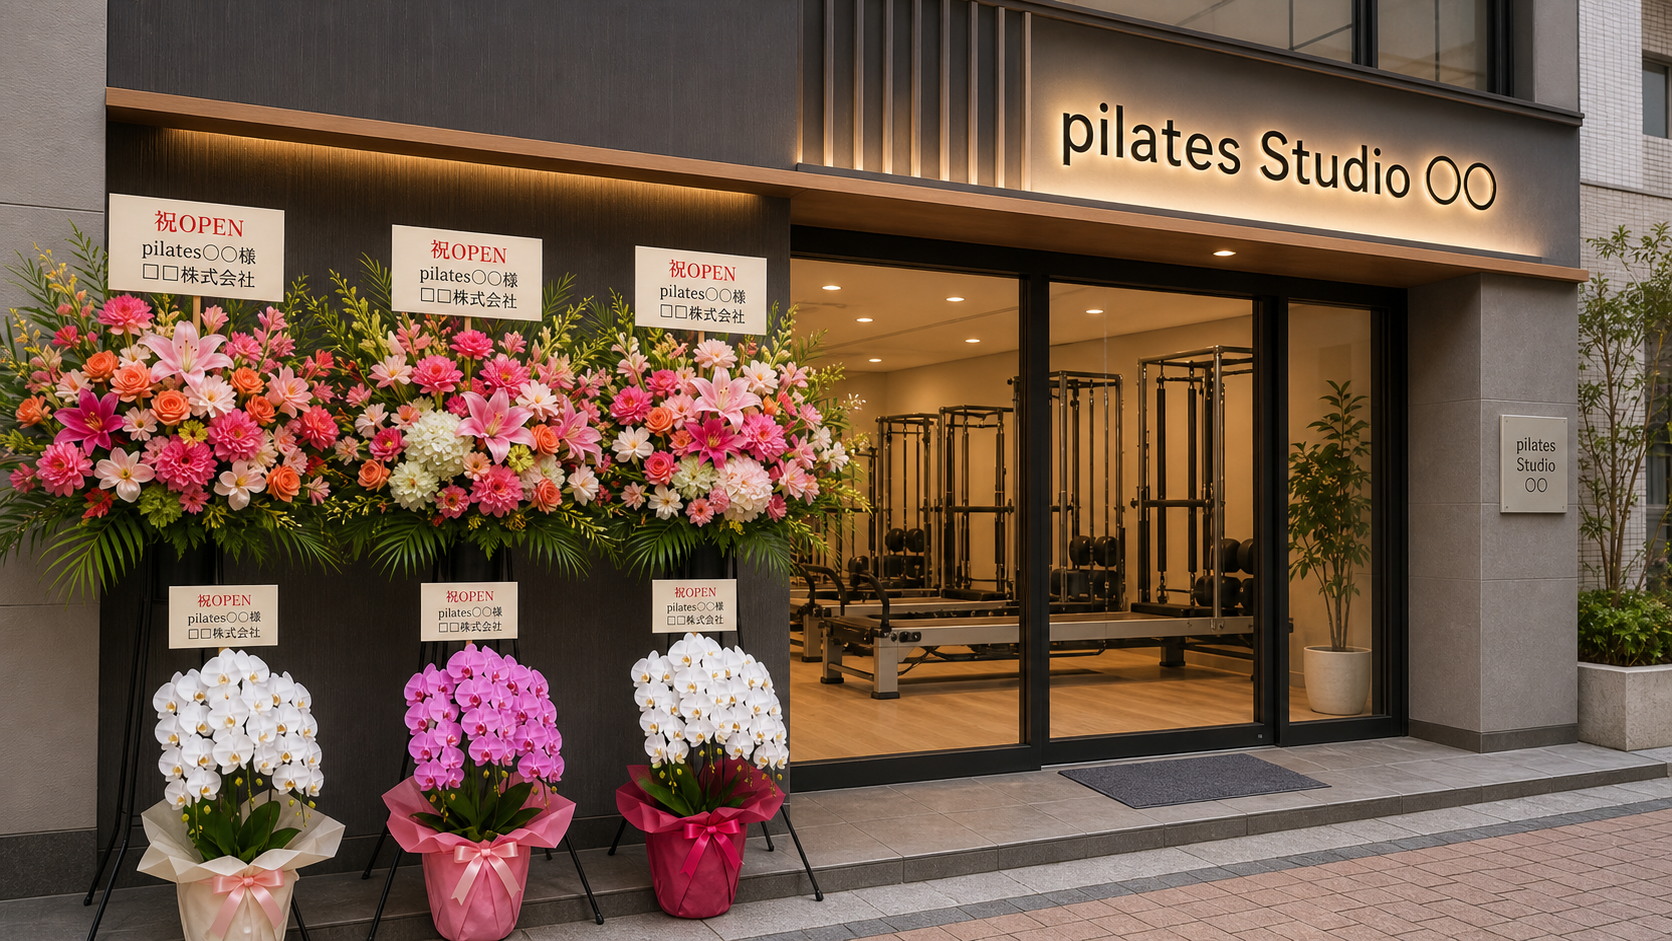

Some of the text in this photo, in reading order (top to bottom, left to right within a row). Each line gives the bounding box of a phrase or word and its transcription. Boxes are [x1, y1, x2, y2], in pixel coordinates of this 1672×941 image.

[1062, 102, 1241, 175] pilates
[1260, 130, 1411, 198] Studio
[154, 210, 244, 237] 祝OPEN
[430, 239, 508, 264] 祝OPEN
[669, 259, 736, 282] 祝OPEN
[1516, 437, 1556, 454] pilates
[1516, 457, 1556, 472] Studio
[446, 590, 494, 603] 祝OPEN
[675, 586, 717, 598] 祝OPEN
[198, 594, 252, 608] 祝OPEN
